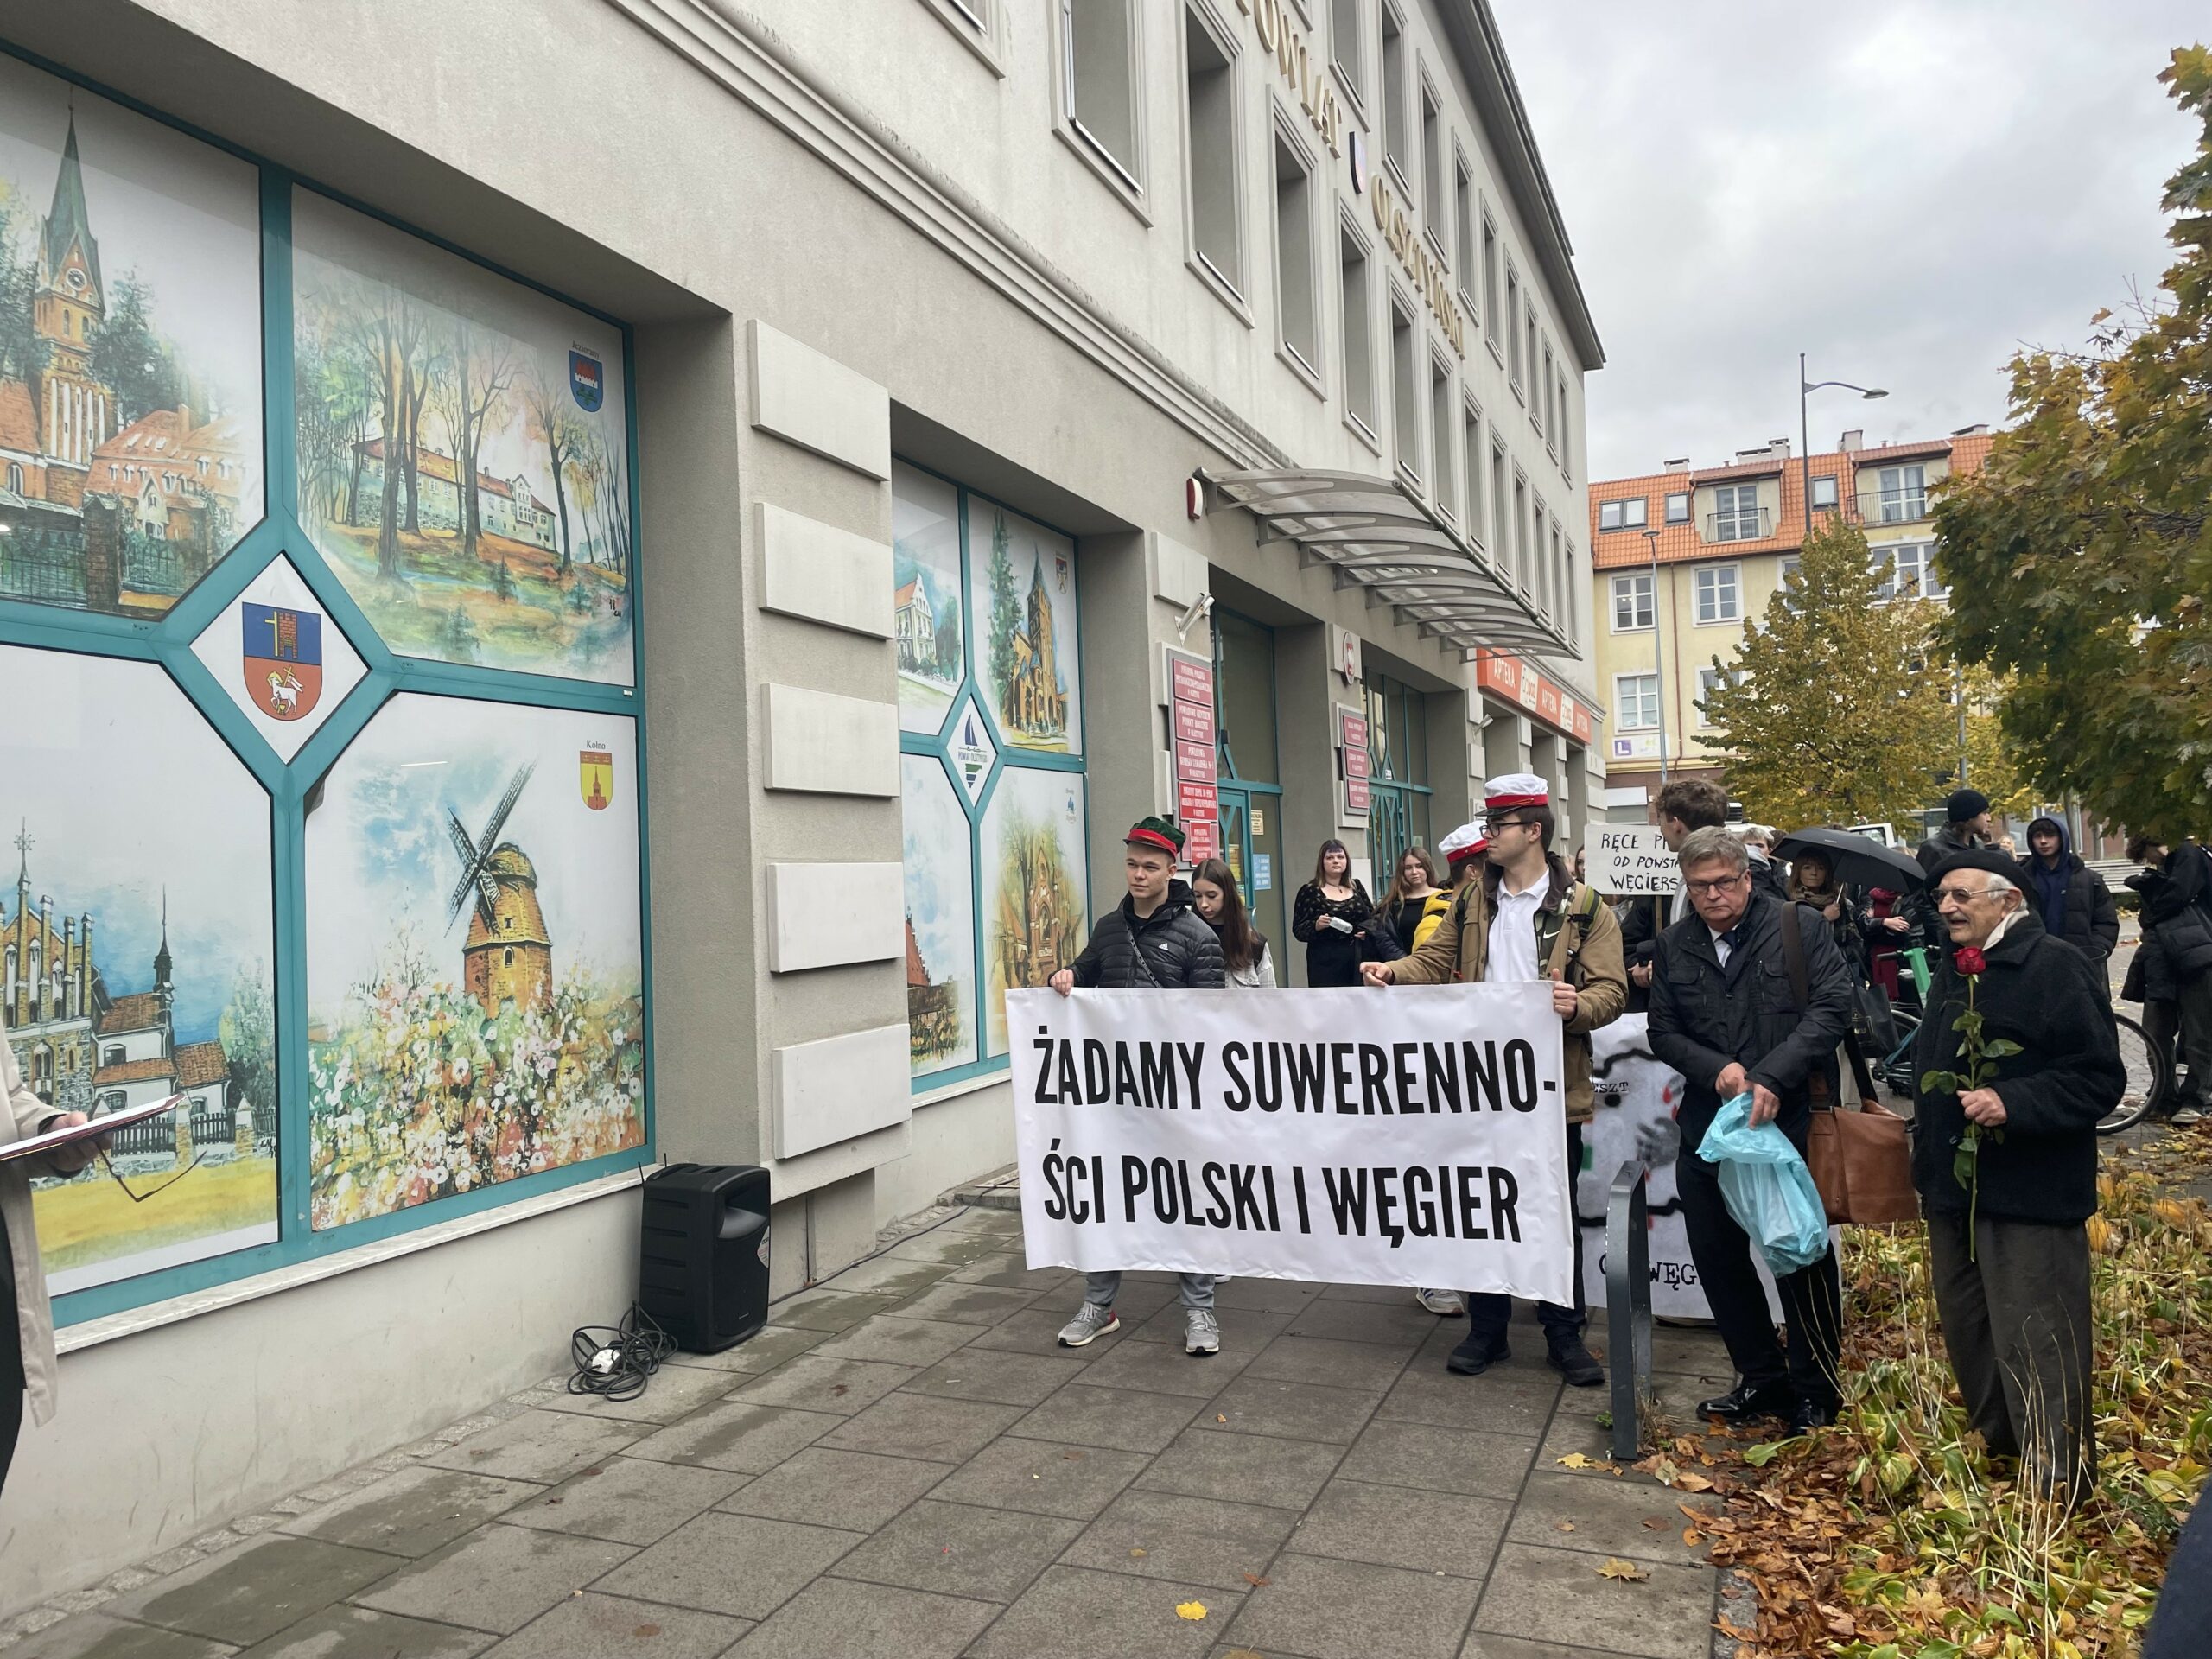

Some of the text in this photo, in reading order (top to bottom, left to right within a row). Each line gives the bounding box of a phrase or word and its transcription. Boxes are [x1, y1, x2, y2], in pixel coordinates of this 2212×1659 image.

[1235, 0, 1342, 159] OWIAT
[1494, 658, 1516, 689] APTEKA
[587, 740, 606, 749] Kolno
[1601, 833, 1639, 852] RĘCE
[1613, 855, 1630, 867] OD
[1223, 1039, 1555, 1114] SUWERENNO-
[1043, 1139, 1521, 1248] ŚCI POLSKI I WĘGIER
